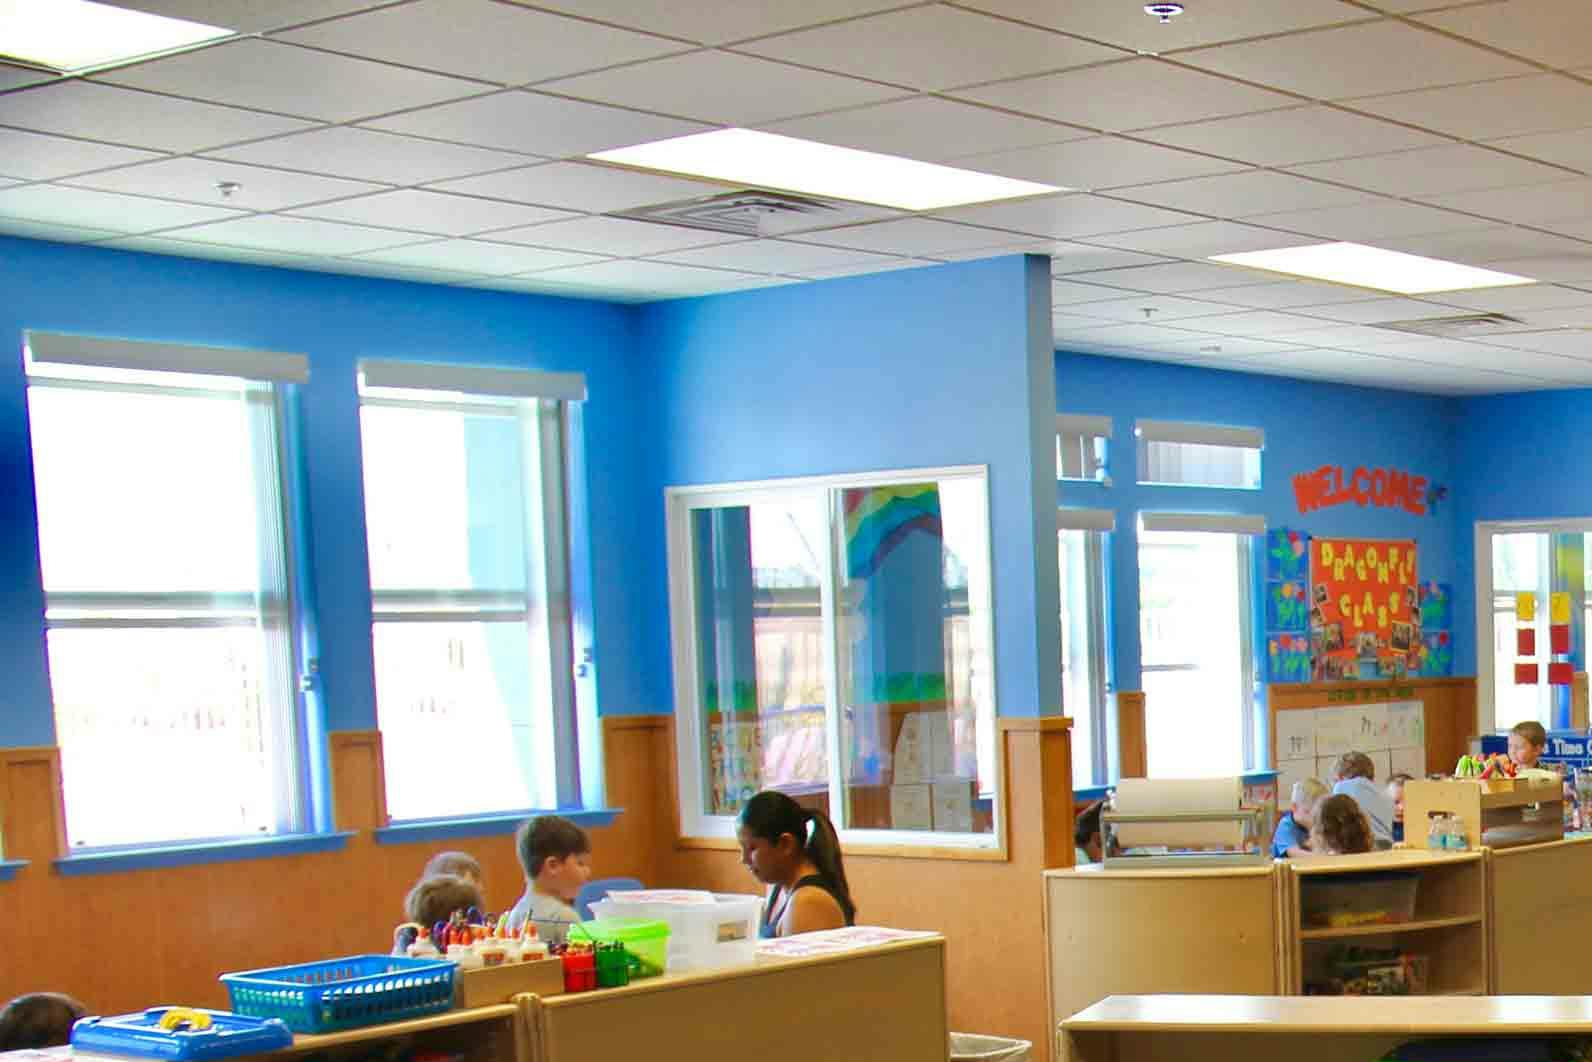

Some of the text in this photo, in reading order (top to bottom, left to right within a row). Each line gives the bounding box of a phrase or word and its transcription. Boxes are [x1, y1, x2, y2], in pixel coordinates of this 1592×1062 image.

[1292, 464, 1425, 515] WELCOME
[1321, 543, 1414, 584] DRAGONFLY
[1339, 592, 1399, 627] CLASS
[1552, 740, 1583, 755] Time
